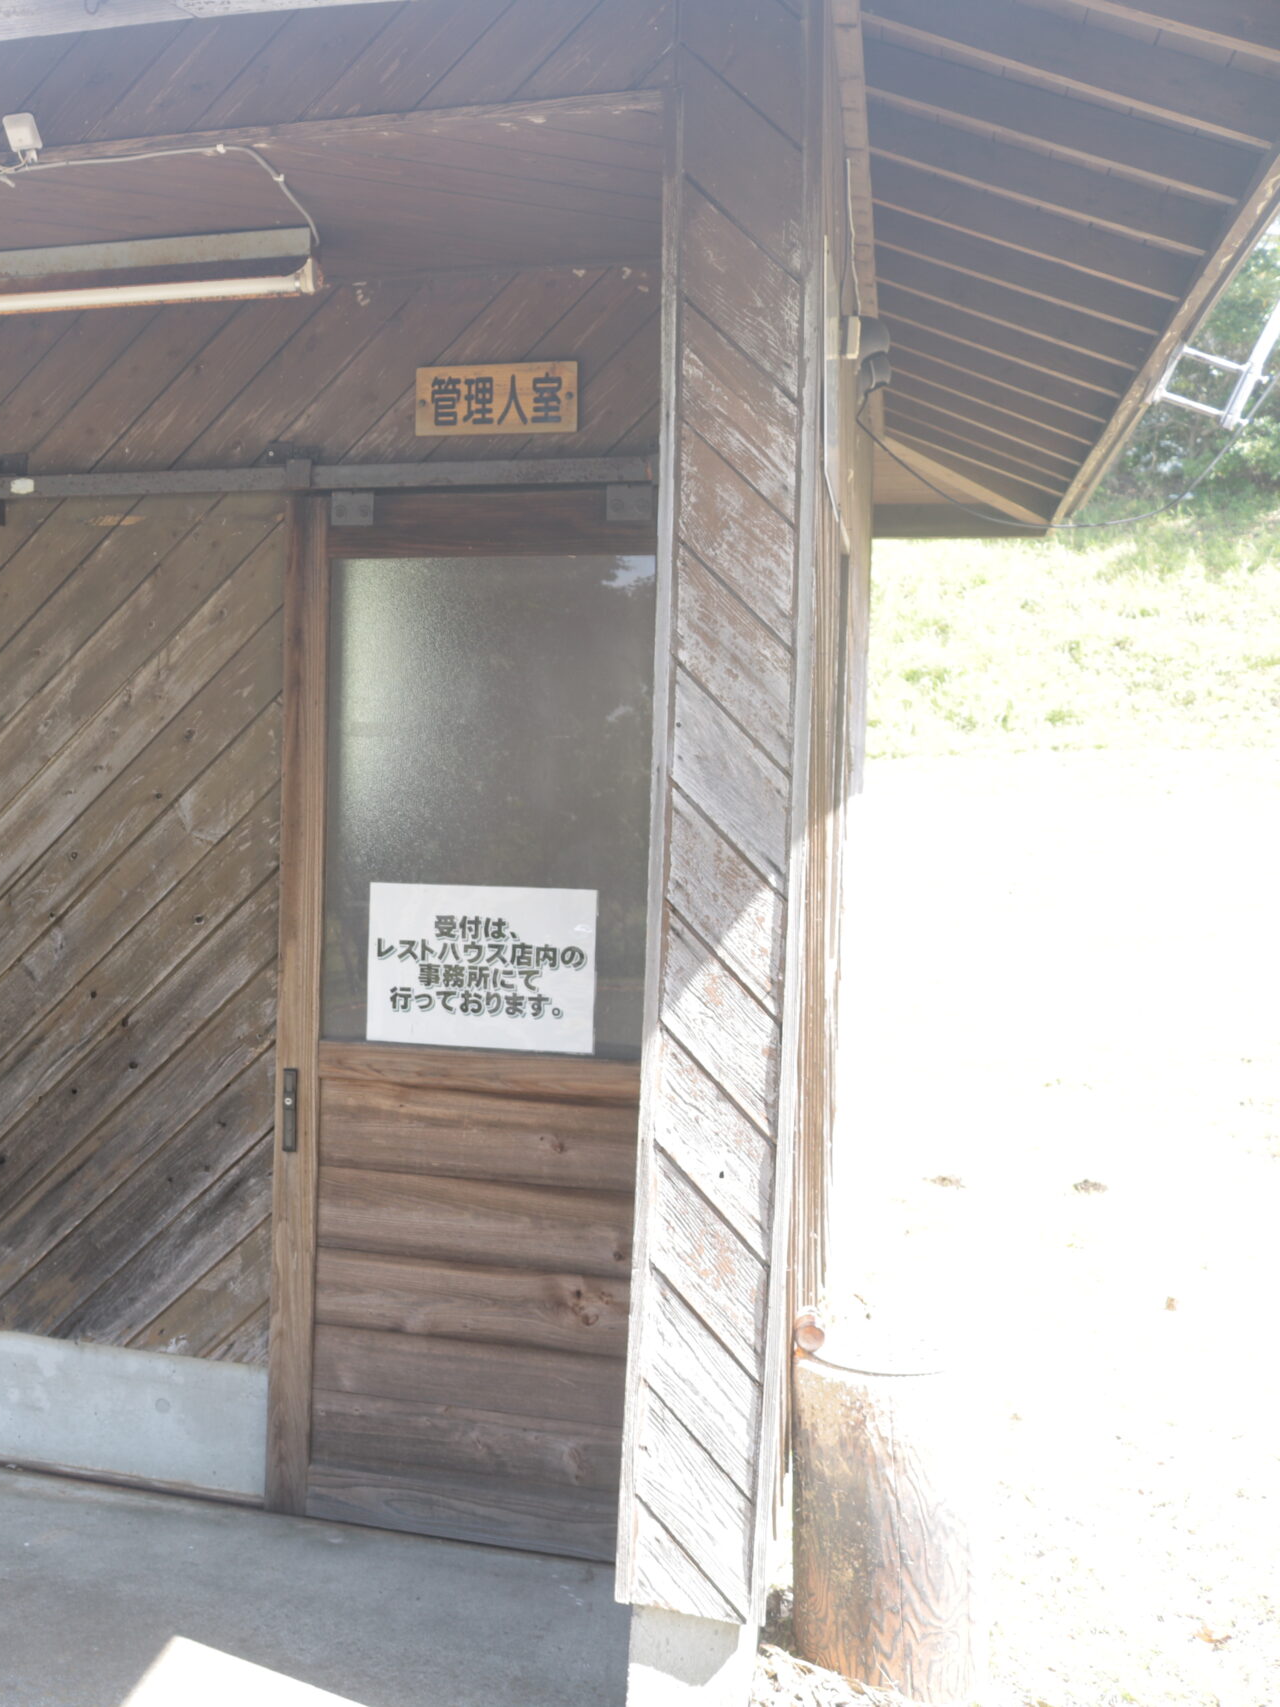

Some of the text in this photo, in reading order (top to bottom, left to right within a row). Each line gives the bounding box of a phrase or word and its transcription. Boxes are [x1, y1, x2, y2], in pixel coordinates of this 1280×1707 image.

[431, 372, 563, 427] 管理人室
[434, 915, 521, 941] 受付は、
[376, 937, 588, 972] レストハウス店内の
[418, 963, 542, 992] 事務所にて
[389, 986, 564, 1020] 行っております。
